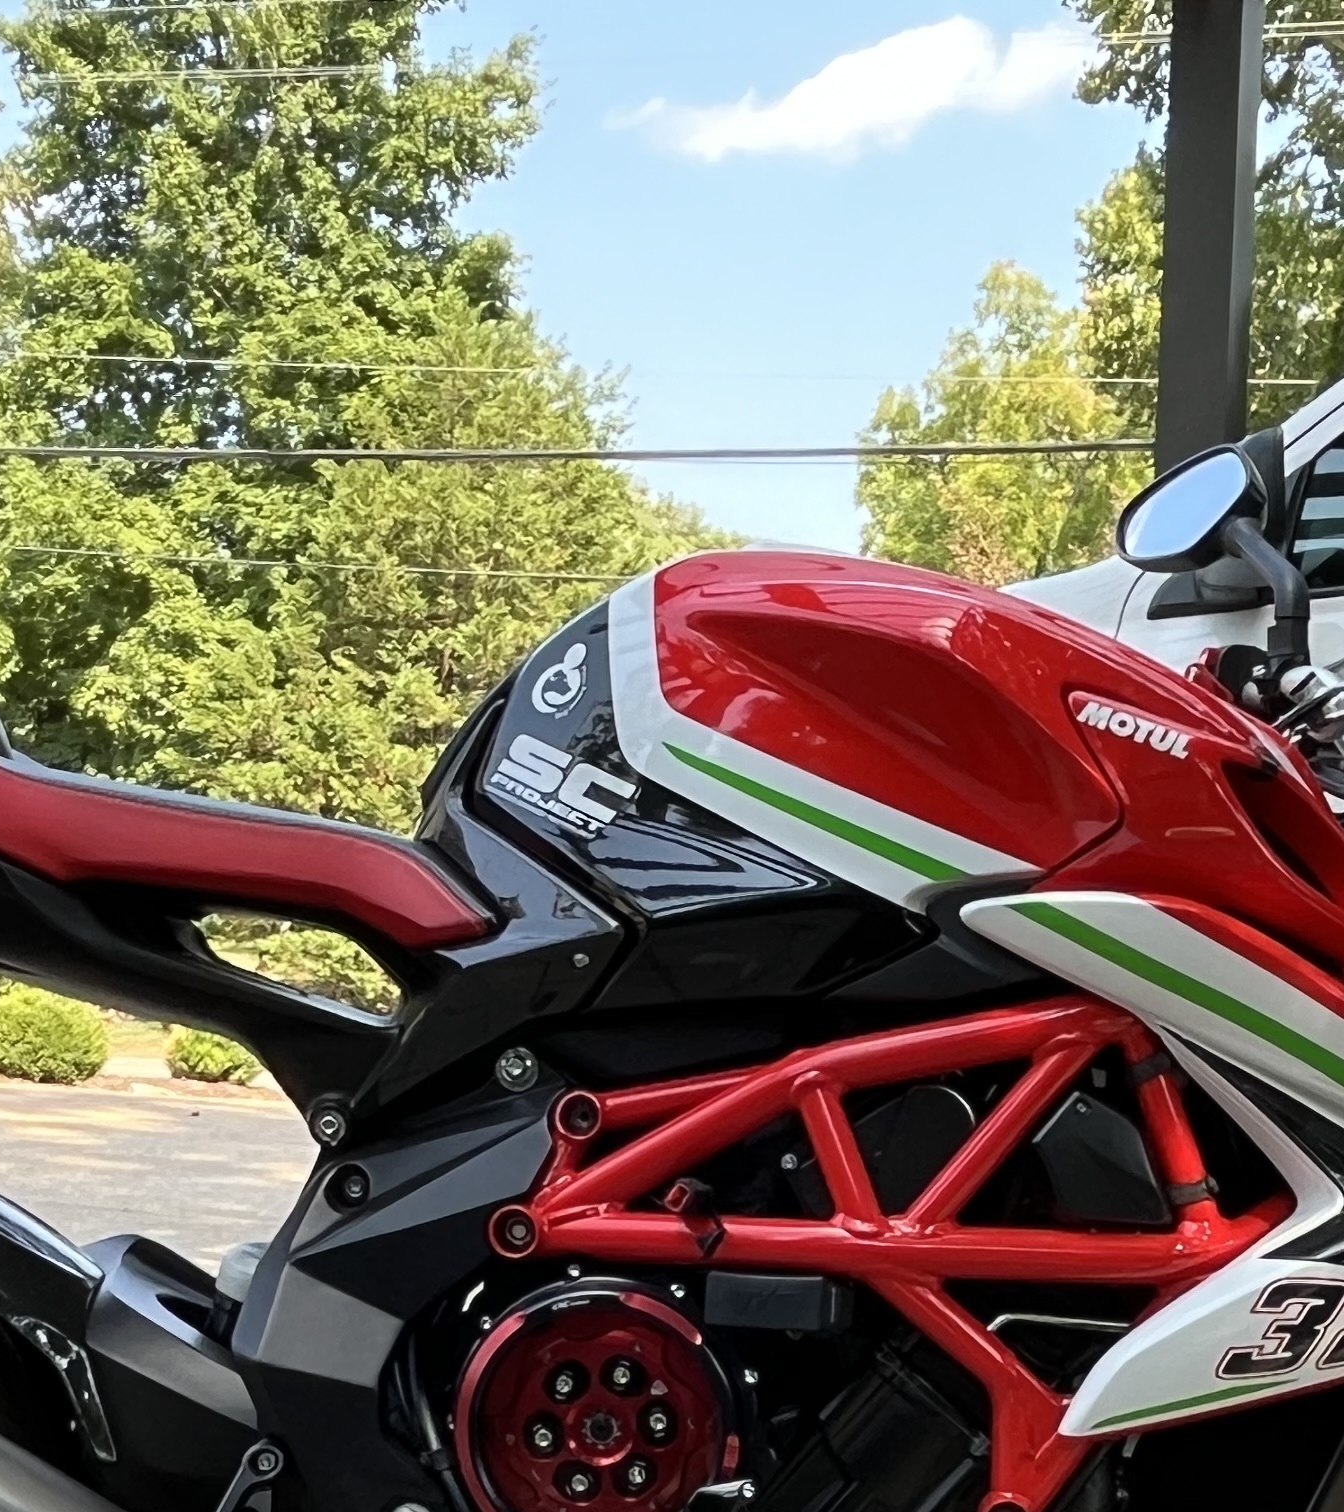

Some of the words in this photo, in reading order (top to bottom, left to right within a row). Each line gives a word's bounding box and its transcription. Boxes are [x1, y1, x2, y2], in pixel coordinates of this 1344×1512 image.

[1076, 702, 1193, 760] MOTUL
[490, 772, 607, 837] PROJECT
[497, 733, 638, 825] SC
